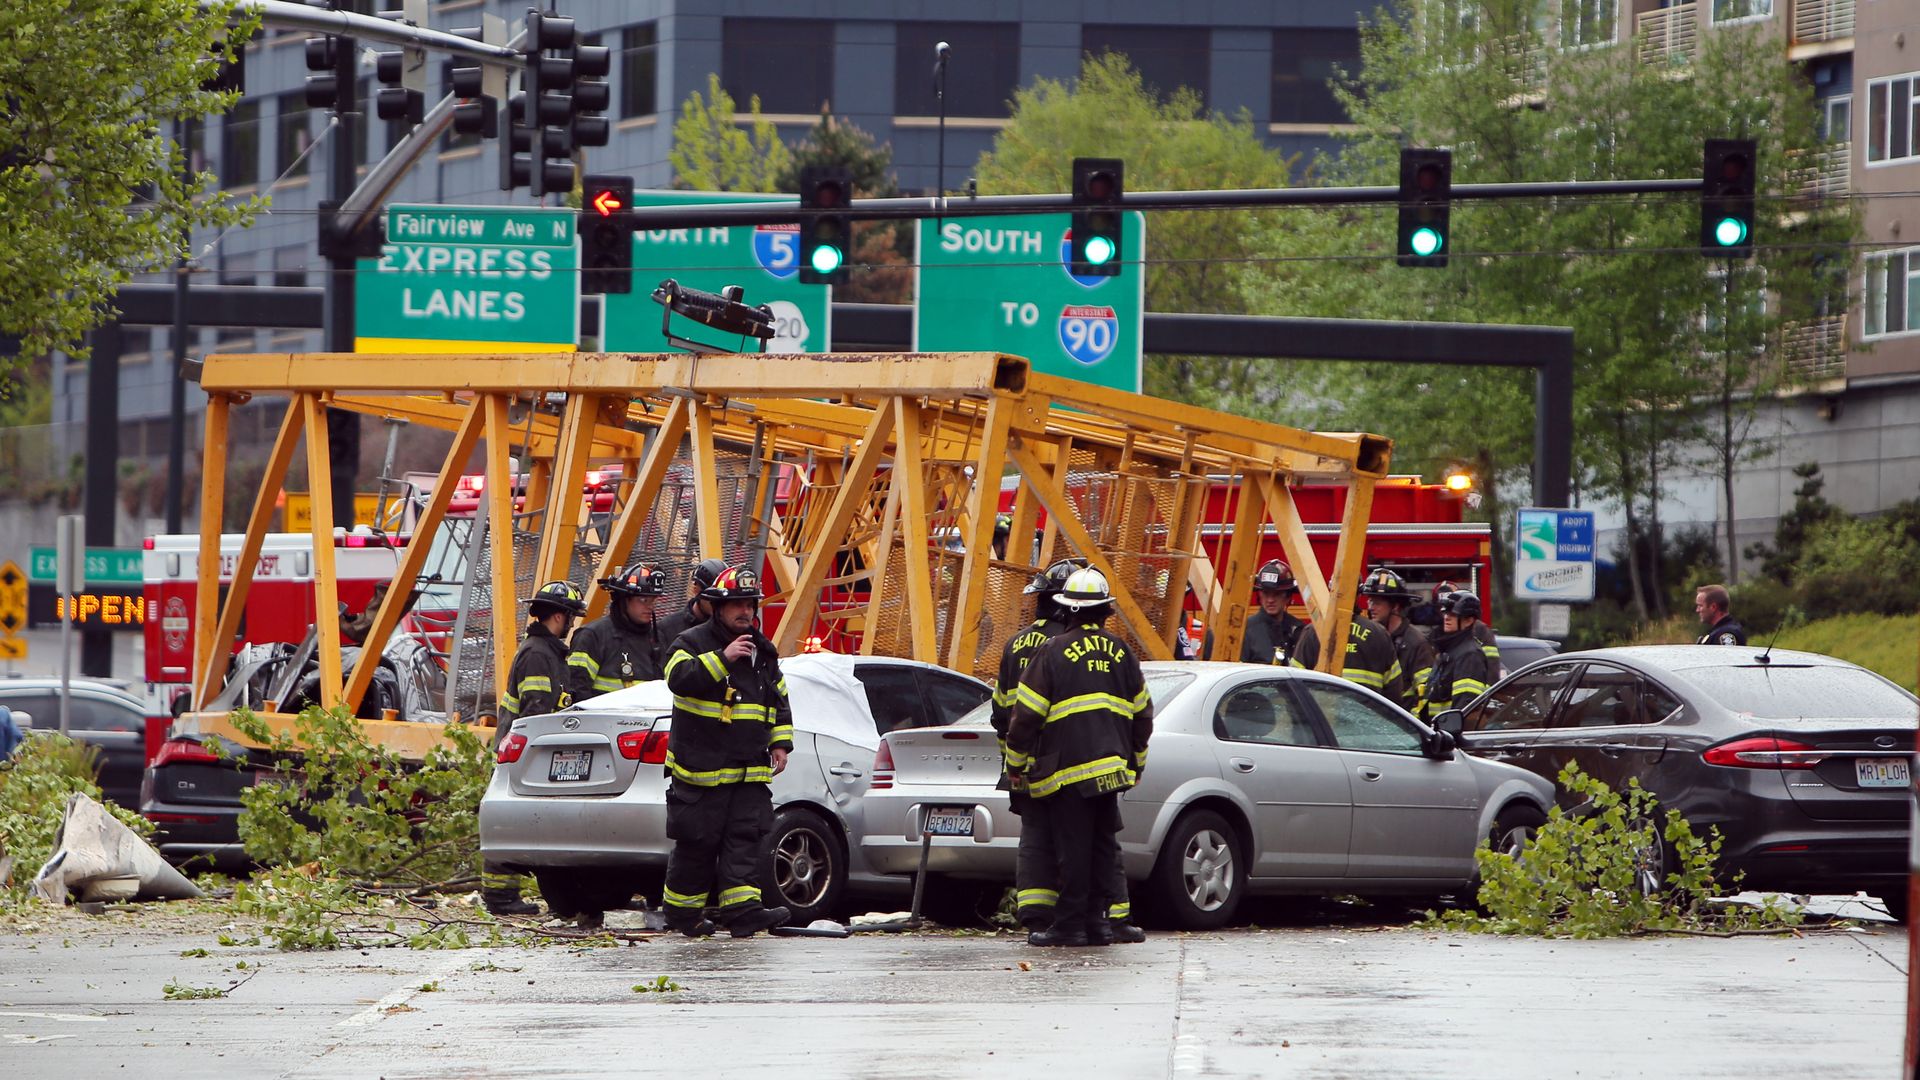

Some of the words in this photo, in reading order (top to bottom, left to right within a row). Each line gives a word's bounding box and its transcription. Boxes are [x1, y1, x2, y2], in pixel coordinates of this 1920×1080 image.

[397, 213, 485, 236] Fairview
[502, 219, 535, 238] Ave
[553, 220, 567, 239] N
[940, 223, 1043, 254] SOUTH
[378, 246, 552, 281] EXPRESS
[771, 233, 794, 268] 5
[402, 288, 526, 320] LANES
[1002, 301, 1040, 325] TO
[776, 317, 802, 338] 20
[1065, 319, 1111, 352] 90
[1563, 517, 1588, 527] ADOPT
[1571, 530, 1579, 540] A
[1559, 544, 1591, 553] HIGHWAY
[1064, 635, 1125, 662] SEATTLE
[1087, 660, 1111, 673] FIRE
